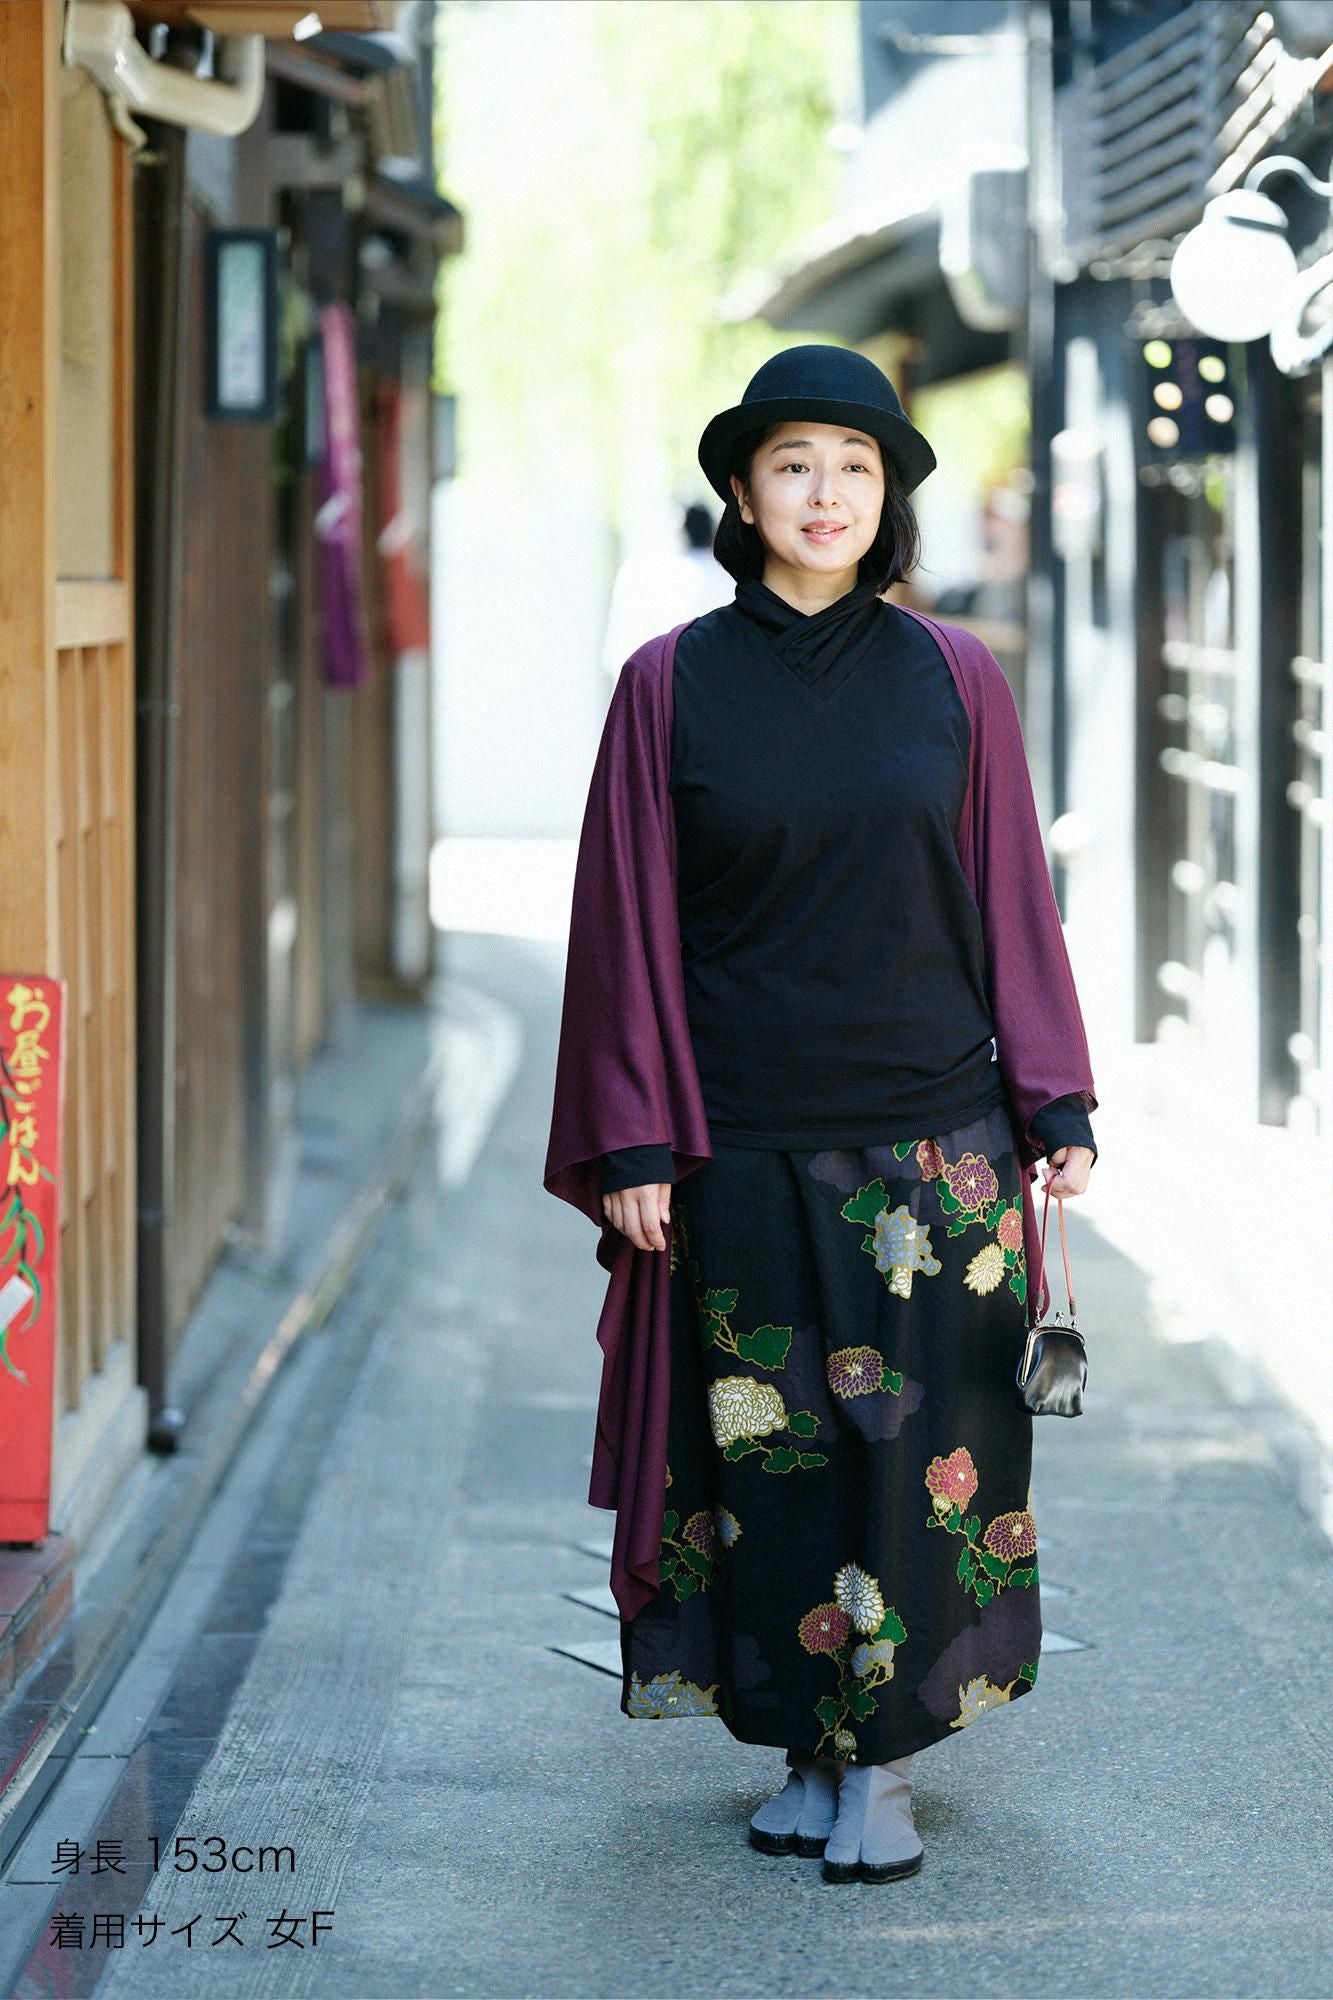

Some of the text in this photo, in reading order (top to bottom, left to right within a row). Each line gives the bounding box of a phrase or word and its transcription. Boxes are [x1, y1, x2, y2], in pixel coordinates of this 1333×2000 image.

[6, 982, 51, 1187] お昼ごはん
